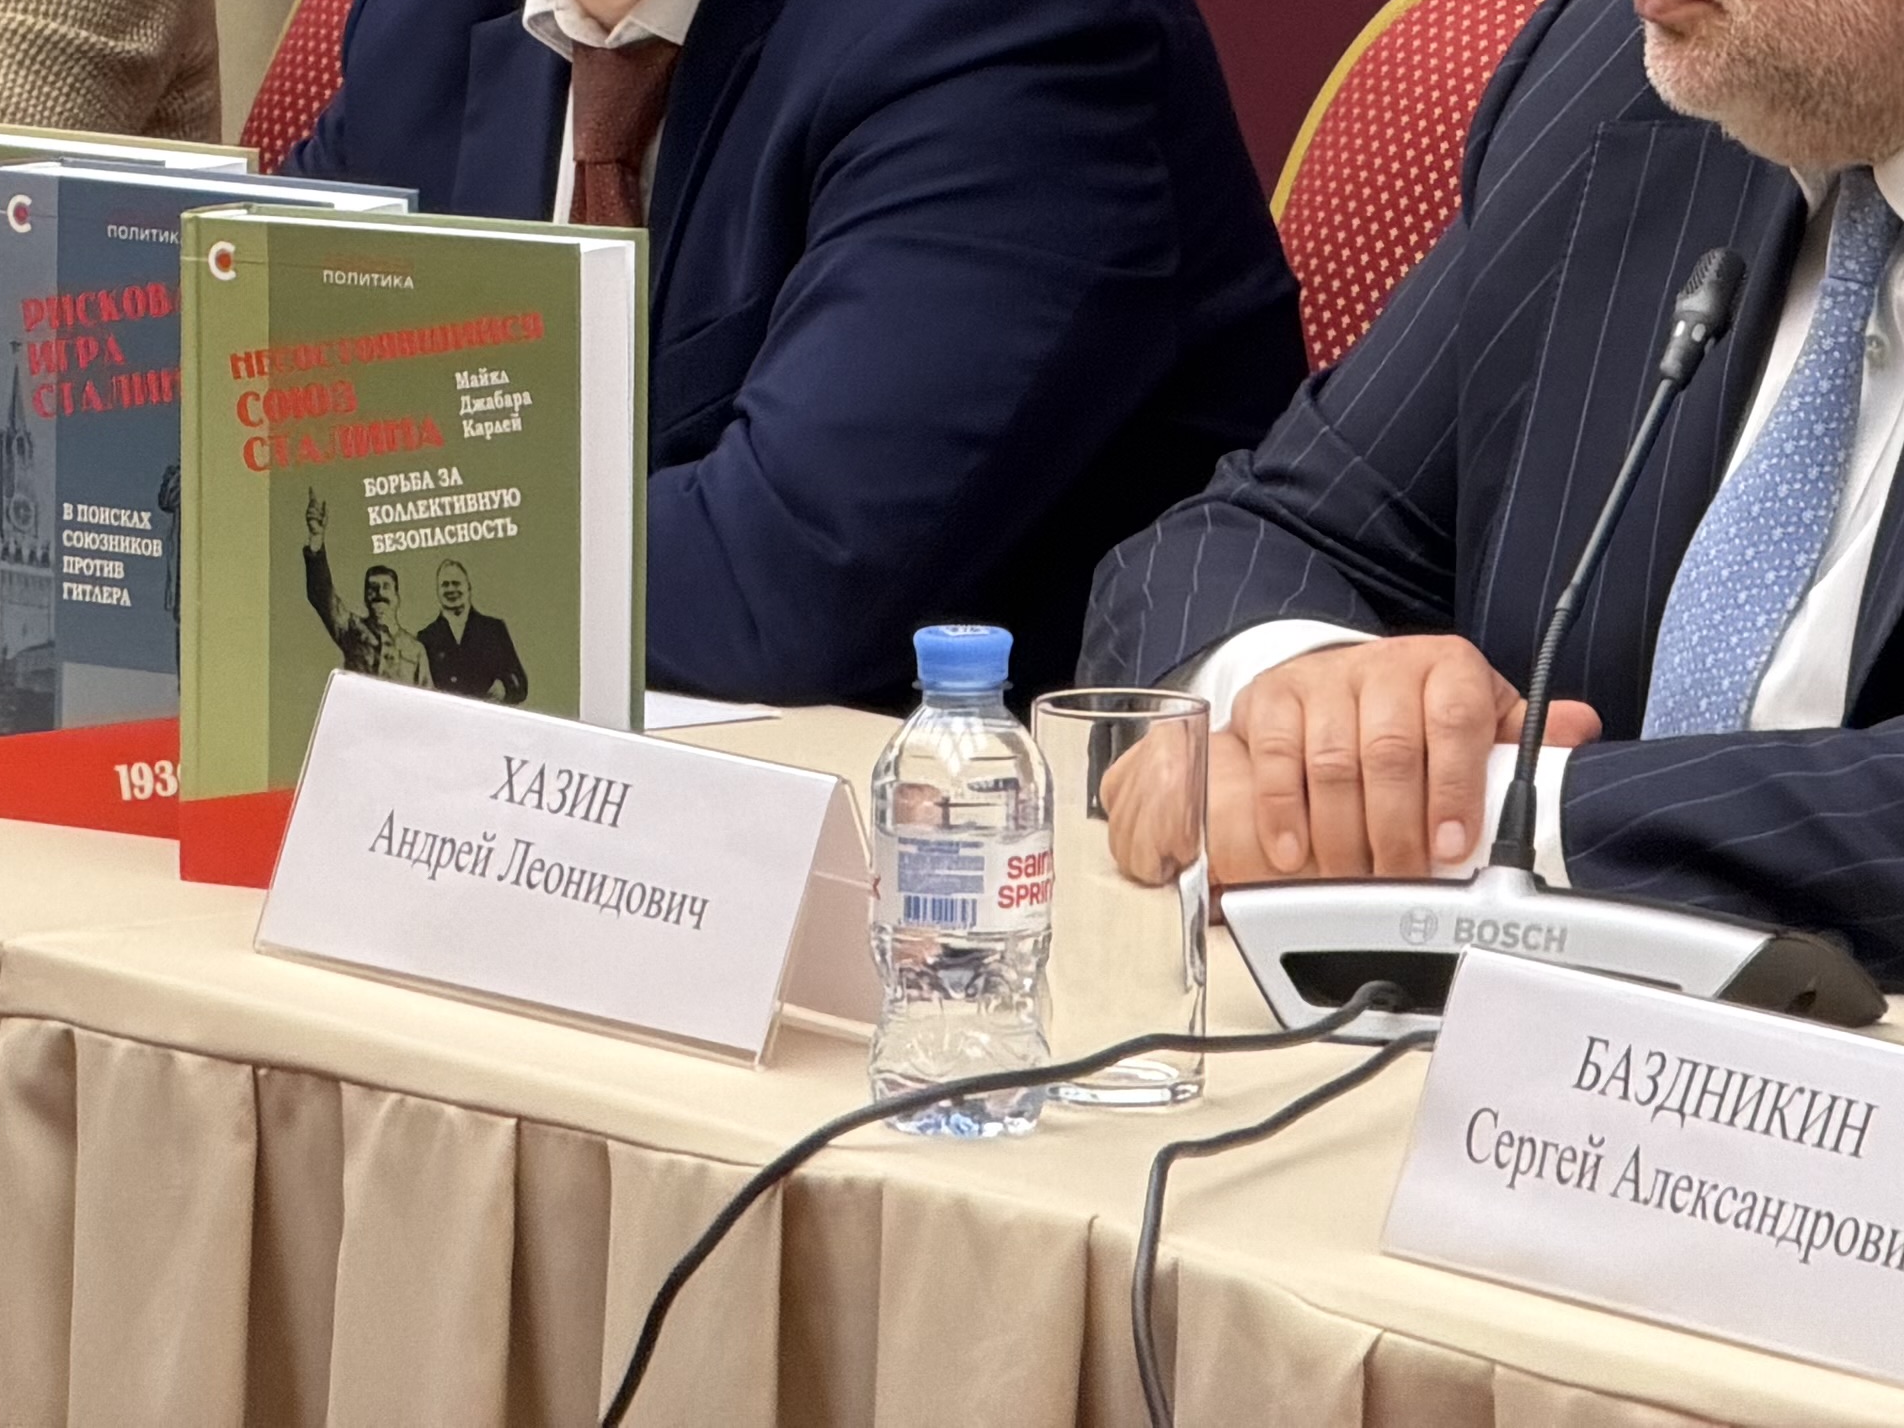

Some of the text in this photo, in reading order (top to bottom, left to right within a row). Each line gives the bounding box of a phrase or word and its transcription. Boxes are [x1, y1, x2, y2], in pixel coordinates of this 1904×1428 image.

[107, 224, 181, 245] ПОЛИТИК
[323, 269, 414, 290] ПОЛИТИКА
[21, 282, 181, 332] РИСКОВ
[28, 333, 125, 376] ИГРА
[32, 368, 181, 420] СТАЛИН
[454, 367, 510, 391] Майкл
[236, 380, 358, 429] СОЮЗ
[459, 389, 533, 417] Джабара
[242, 413, 446, 473] СТАЛИНА
[462, 414, 523, 441] Карлей
[363, 466, 463, 498] БОРЬБА ЗА
[63, 503, 152, 530] В ПОИСКАХ
[367, 487, 522, 527] КОЛЛЕКТИВНУЮ
[63, 529, 164, 558] СОЮЗНИКОВ
[371, 516, 518, 554] БЕЗОПАСНОСТЬ
[63, 556, 125, 580] ПРОТИВ
[63, 582, 132, 607] ГИТЛЕРА
[489, 754, 633, 829] ХАЗИН
[368, 808, 711, 931] Андрей Леонидович
[1453, 917, 1569, 953] BOSCH
[1571, 1035, 1879, 1160] БАЗДНИКИН
[1465, 1106, 1606, 1194] Сергей
